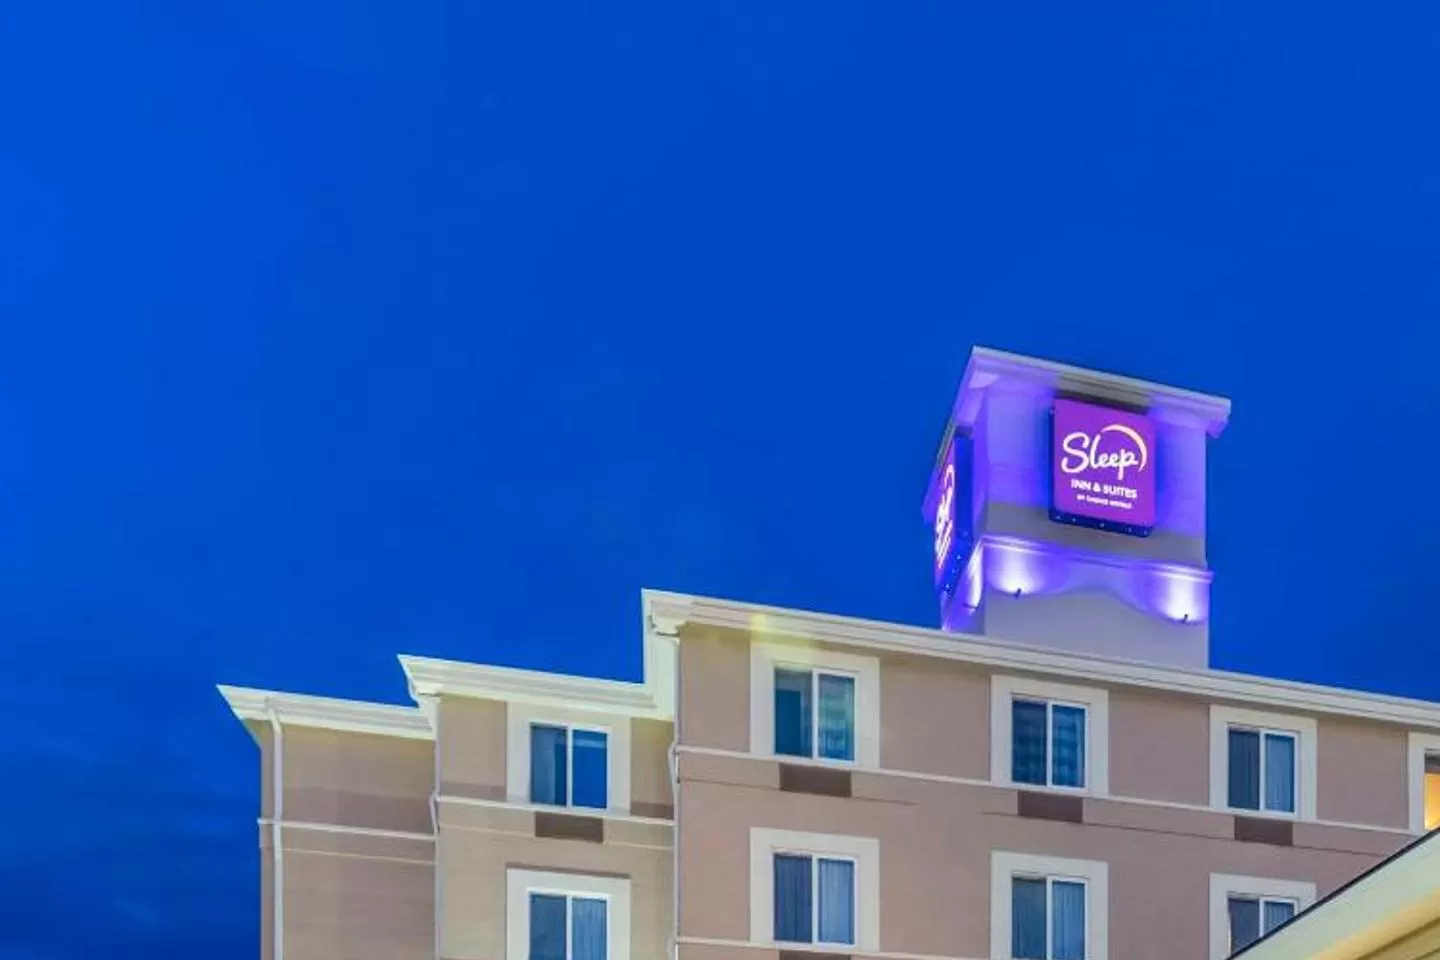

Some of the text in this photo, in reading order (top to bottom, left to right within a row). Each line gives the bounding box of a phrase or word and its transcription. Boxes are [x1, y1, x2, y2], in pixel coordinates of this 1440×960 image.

[1061, 431, 1139, 481] Sleep
[1071, 479, 1138, 499] INN & SUITES
